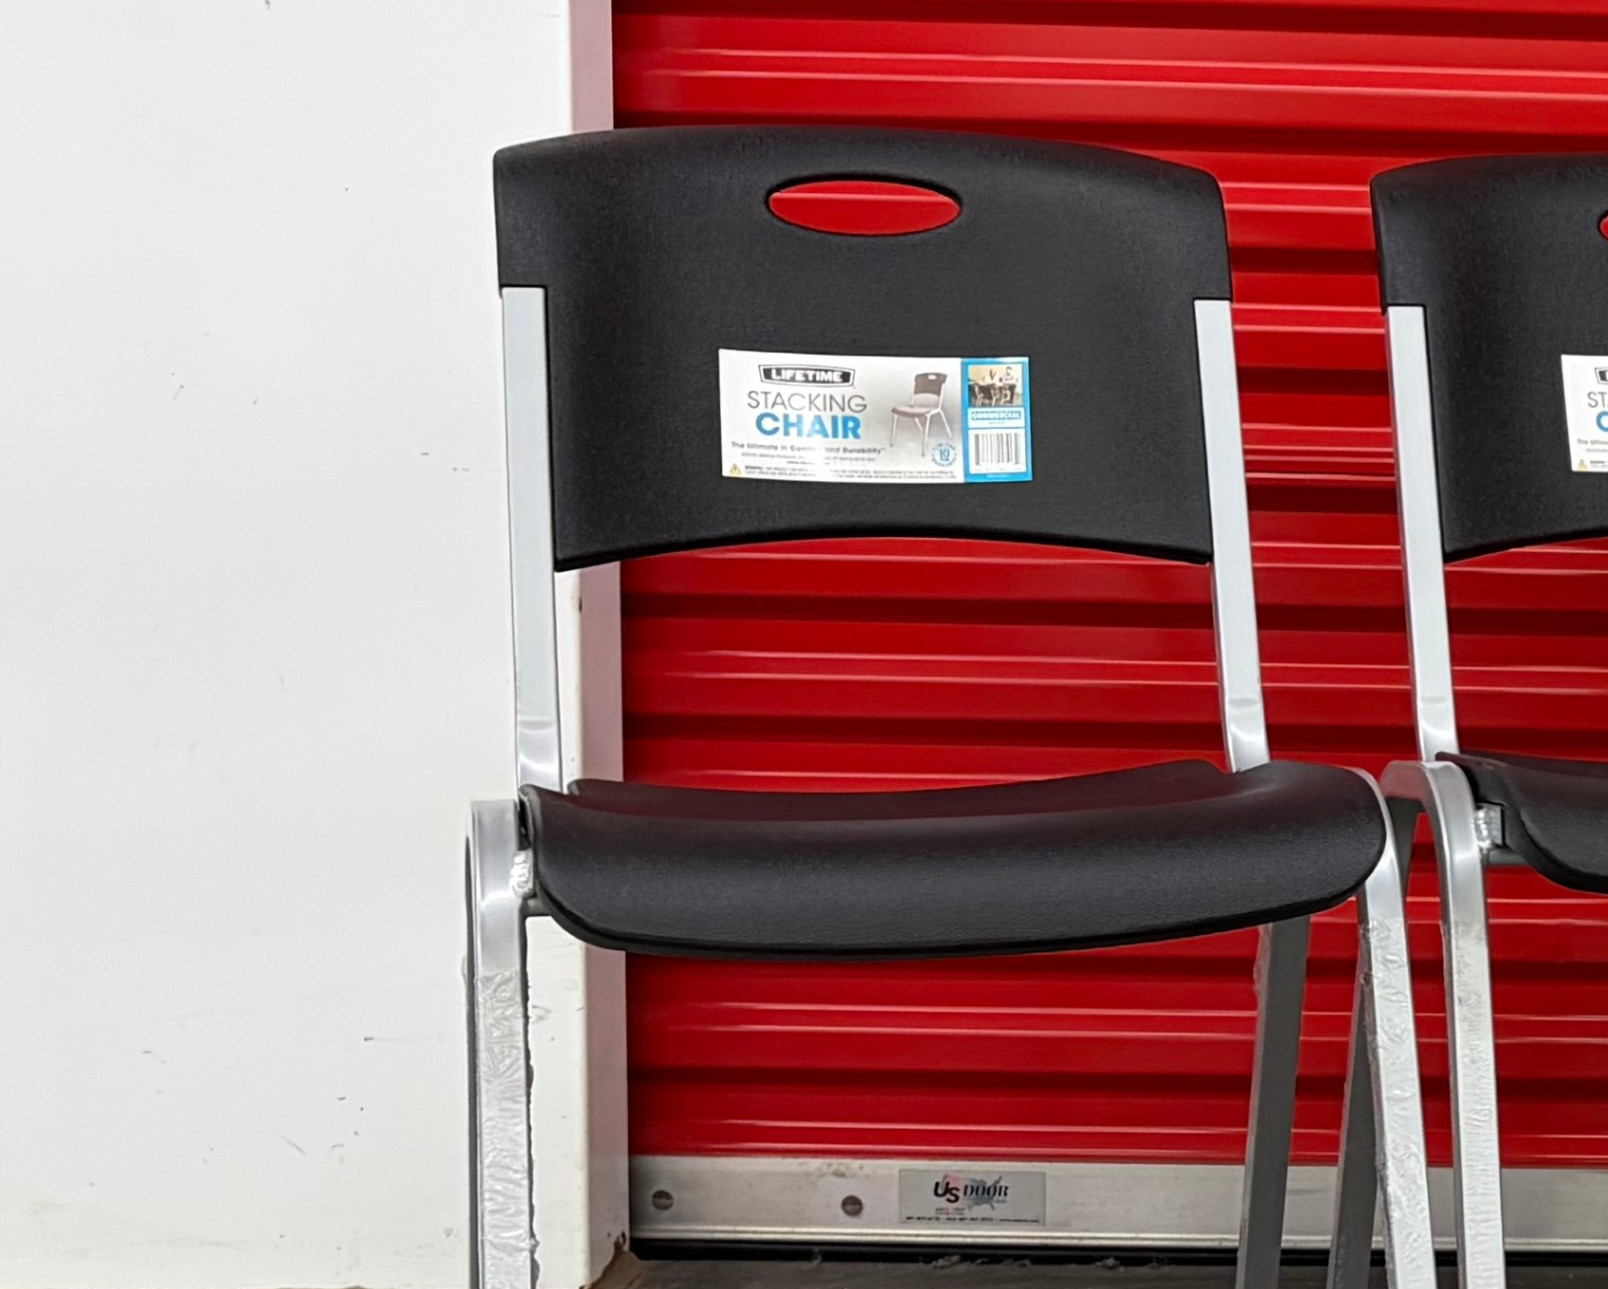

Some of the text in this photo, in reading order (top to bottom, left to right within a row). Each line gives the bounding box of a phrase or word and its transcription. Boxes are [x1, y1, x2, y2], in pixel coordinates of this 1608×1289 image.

[771, 368, 843, 383] LIFETIME
[747, 390, 867, 413] STACKING
[755, 412, 862, 440] CHAIR
[933, 1181, 1009, 1203] US DOOR
